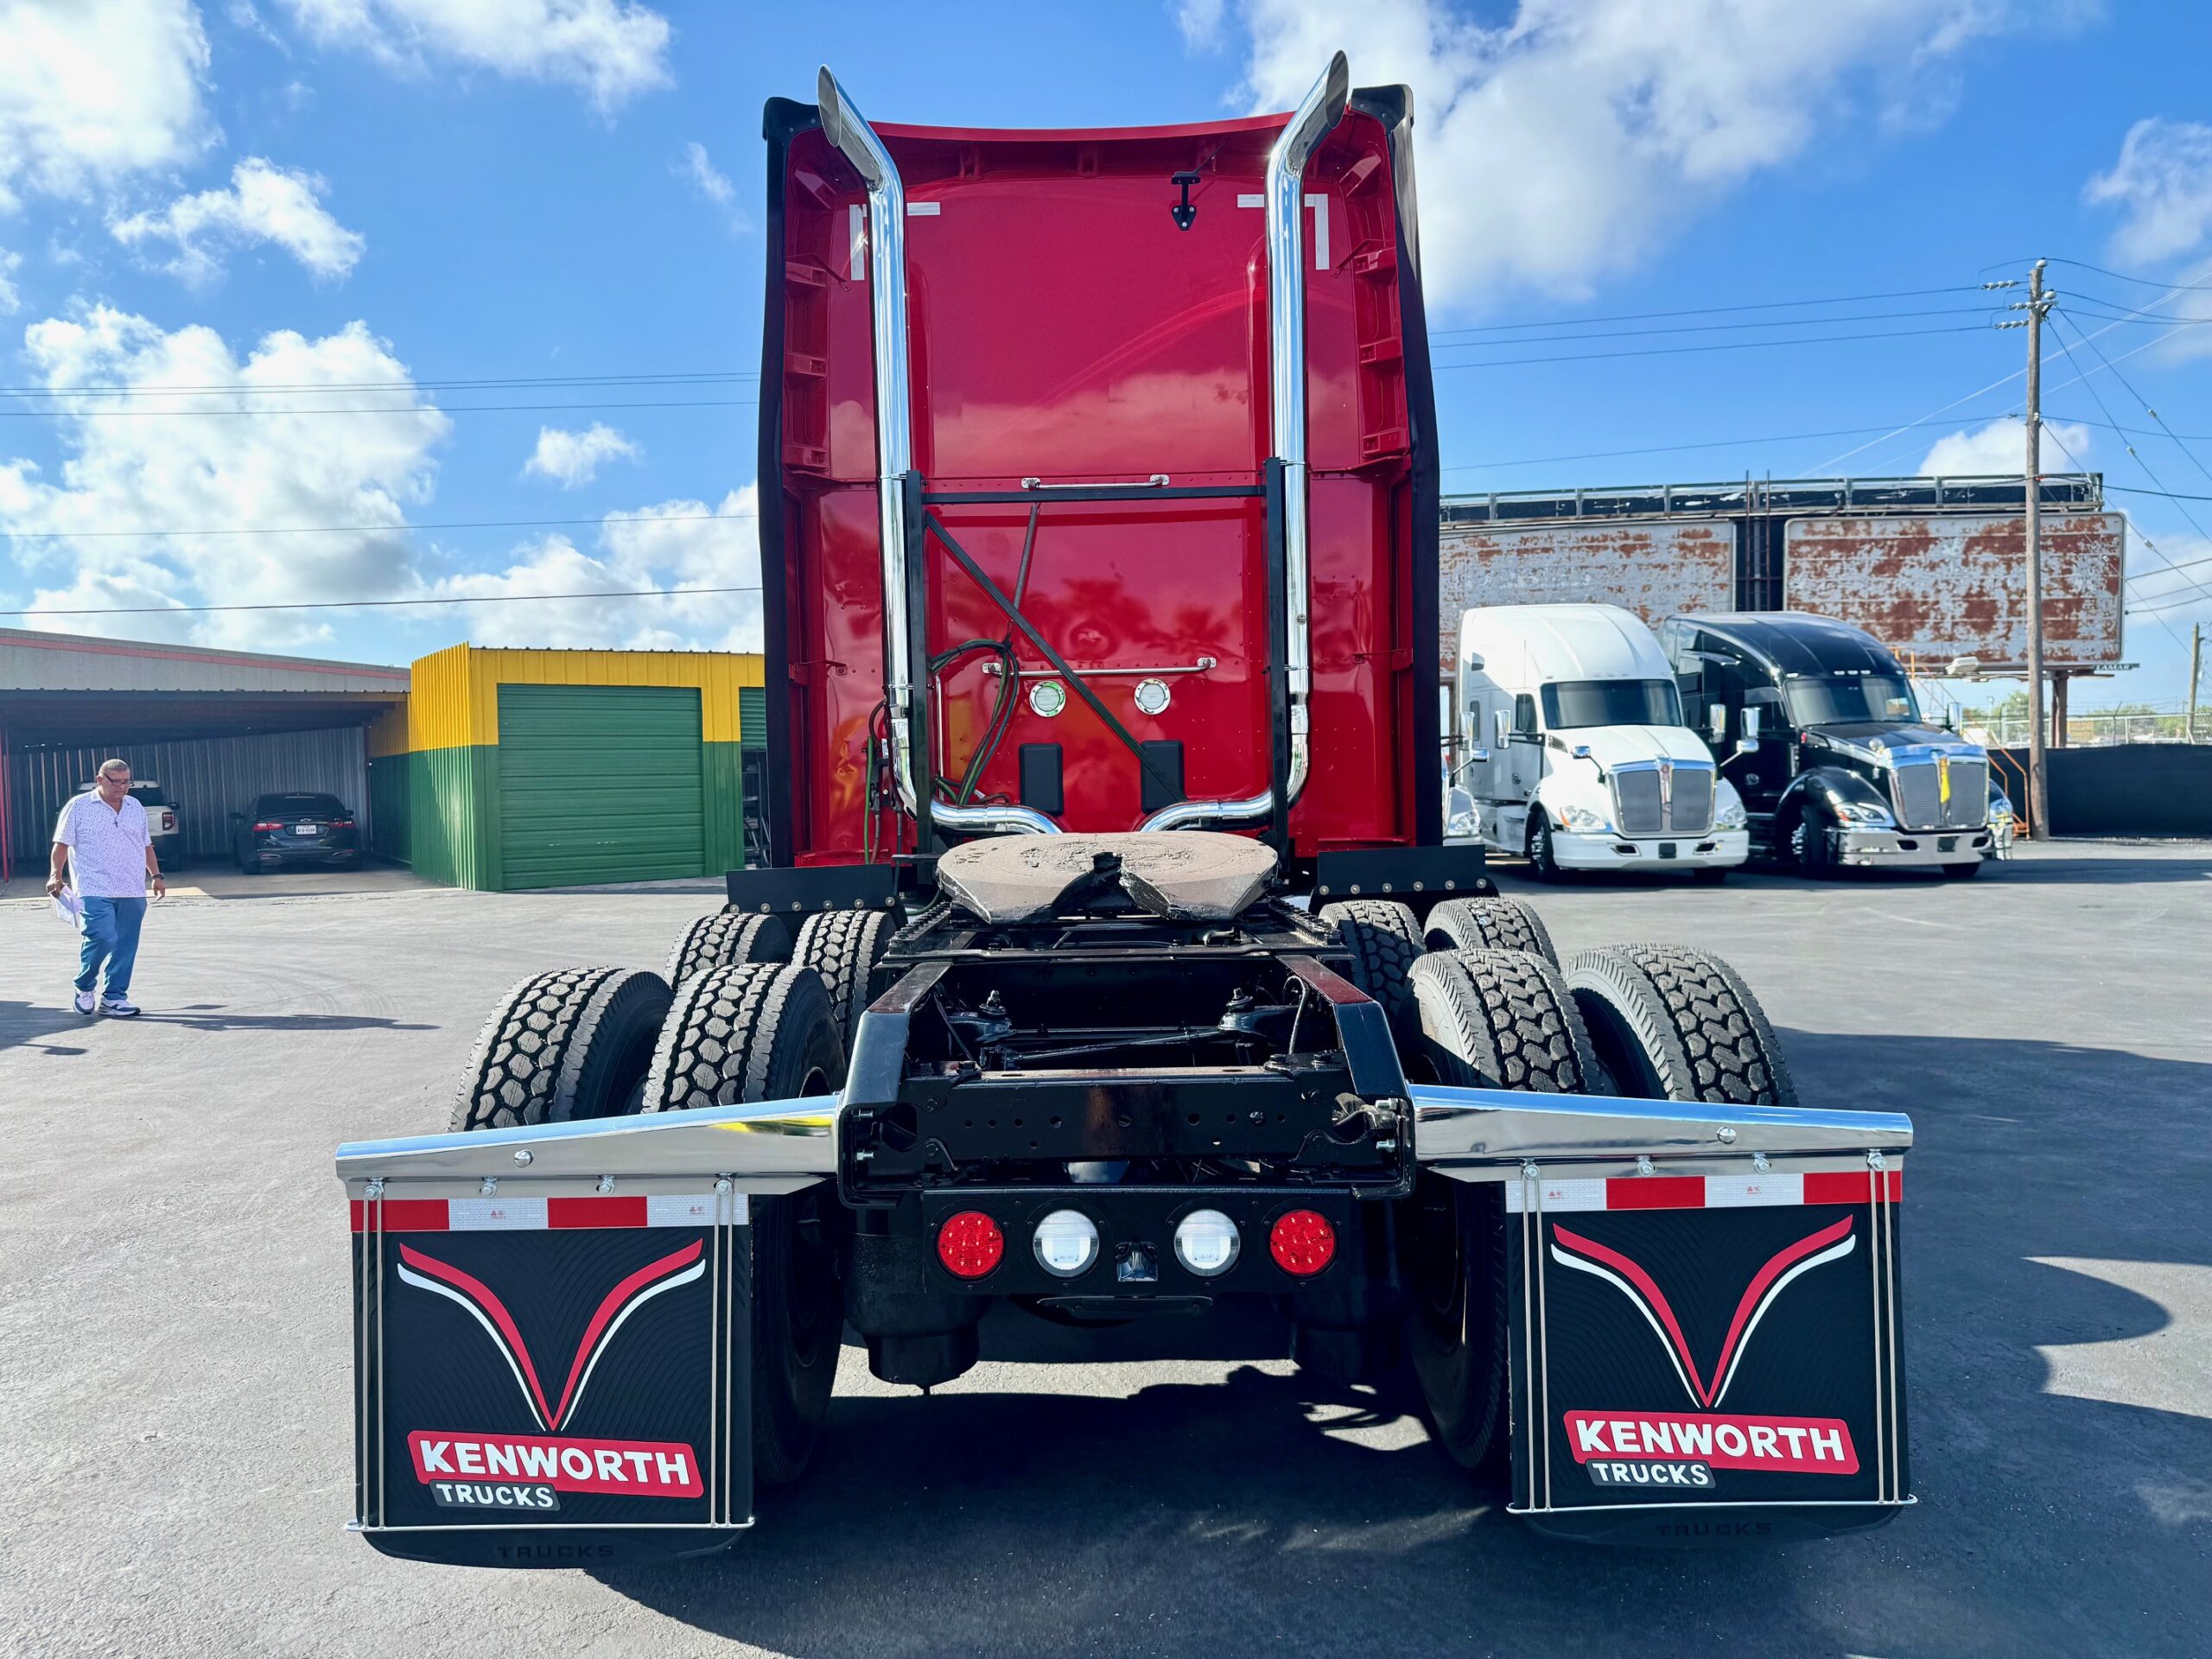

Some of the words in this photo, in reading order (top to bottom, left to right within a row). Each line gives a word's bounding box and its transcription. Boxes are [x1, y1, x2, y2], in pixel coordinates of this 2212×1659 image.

[1575, 1419, 1846, 1461] KENWORTH
[419, 1440, 690, 1485] KENWORTH
[1592, 1463, 1709, 1485] TRUCKS
[435, 1484, 554, 1508] TRUCKS
[1655, 1522, 1773, 1537] TRUCKS
[497, 1545, 615, 1559] TRUCKS
